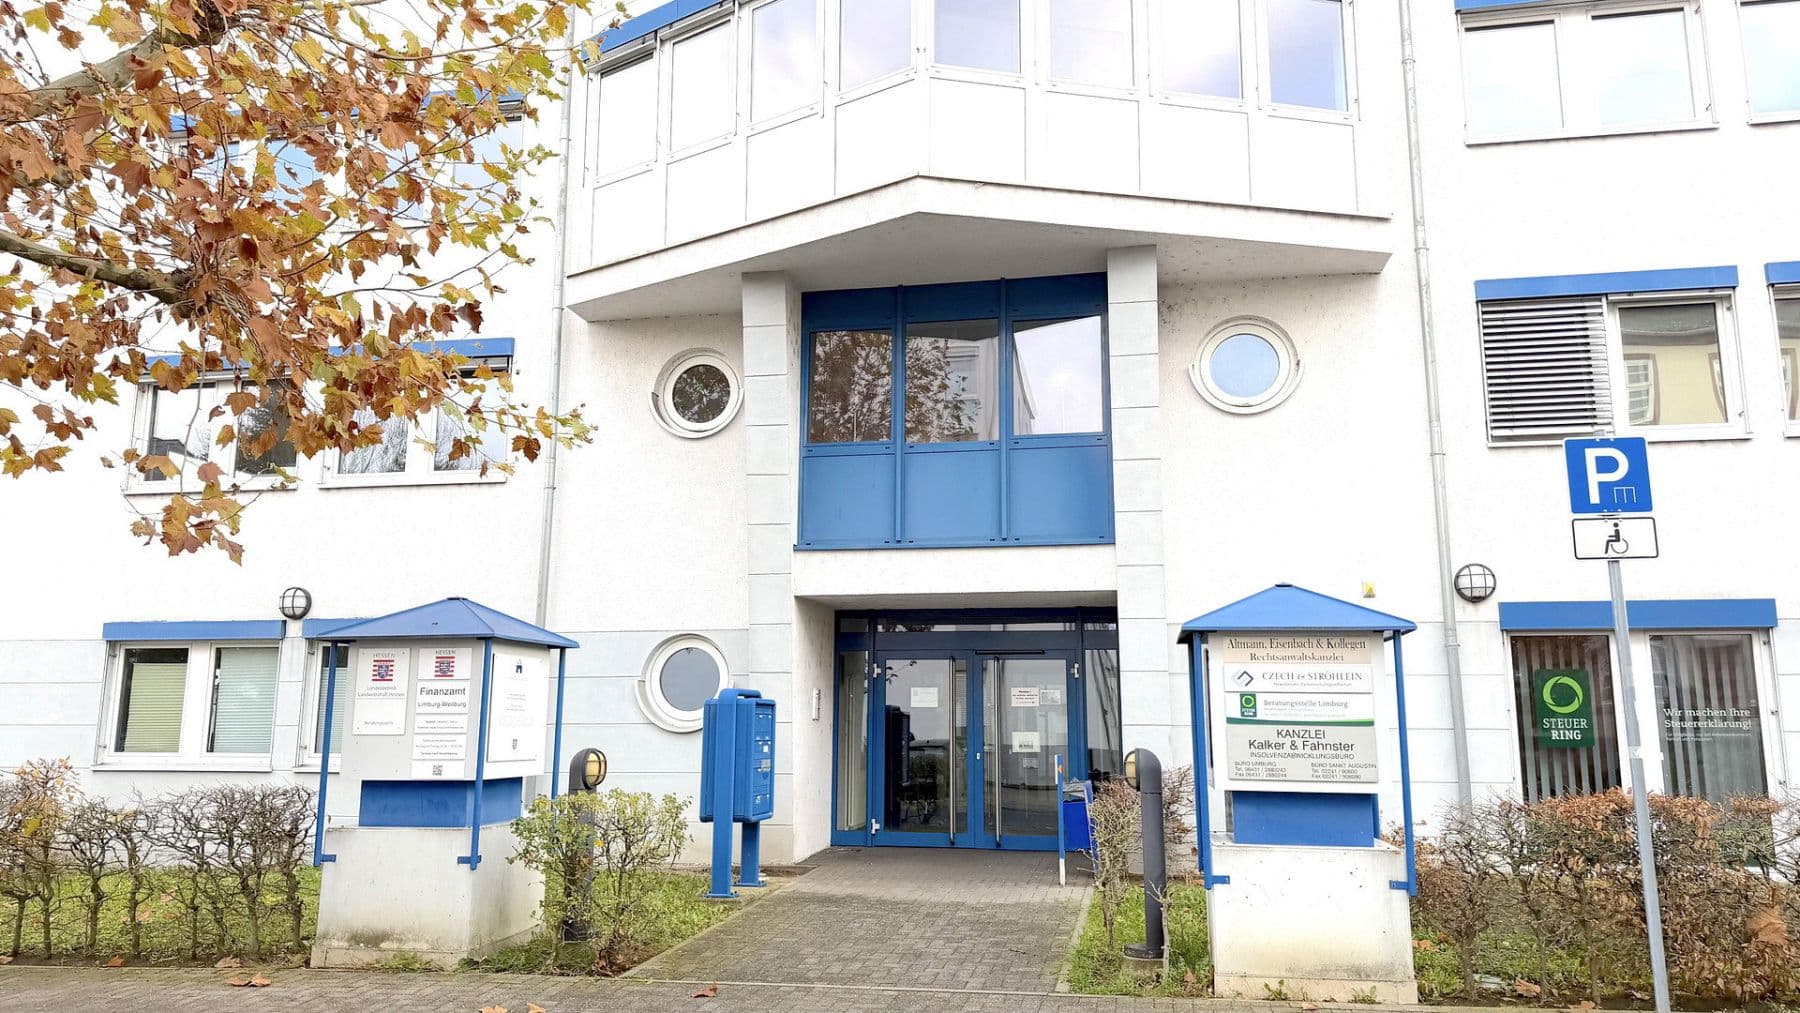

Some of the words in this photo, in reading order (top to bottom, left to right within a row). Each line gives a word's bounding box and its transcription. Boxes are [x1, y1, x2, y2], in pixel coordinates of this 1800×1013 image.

[1584, 447, 1630, 505] P
[1227, 638, 1267, 650] Altmann,
[1269, 637, 1314, 649] Eisenbach
[1315, 638, 1324, 649] &
[1326, 637, 1366, 651] Kollegen
[1250, 652, 1344, 662] Rechtsanwaltskanzlei
[1262, 672, 1294, 681] CZECH
[1296, 672, 1305, 681] &
[419, 687, 466, 696] Finanzamt
[1264, 699, 1317, 708] Beratungsstelle
[1318, 699, 1349, 709] Limburg
[1663, 708, 1682, 717] Wir
[1685, 708, 1726, 717] machen
[1729, 708, 1751, 717] Ihre
[1542, 718, 1588, 729] STEUER
[1664, 719, 1752, 731] Steuererklärung!
[1276, 729, 1326, 740] KANZLEI
[1551, 730, 1582, 740] RING
[1248, 739, 1285, 750] Kalker
[1289, 740, 1299, 750] &
[1302, 740, 1355, 752] Fahnster
